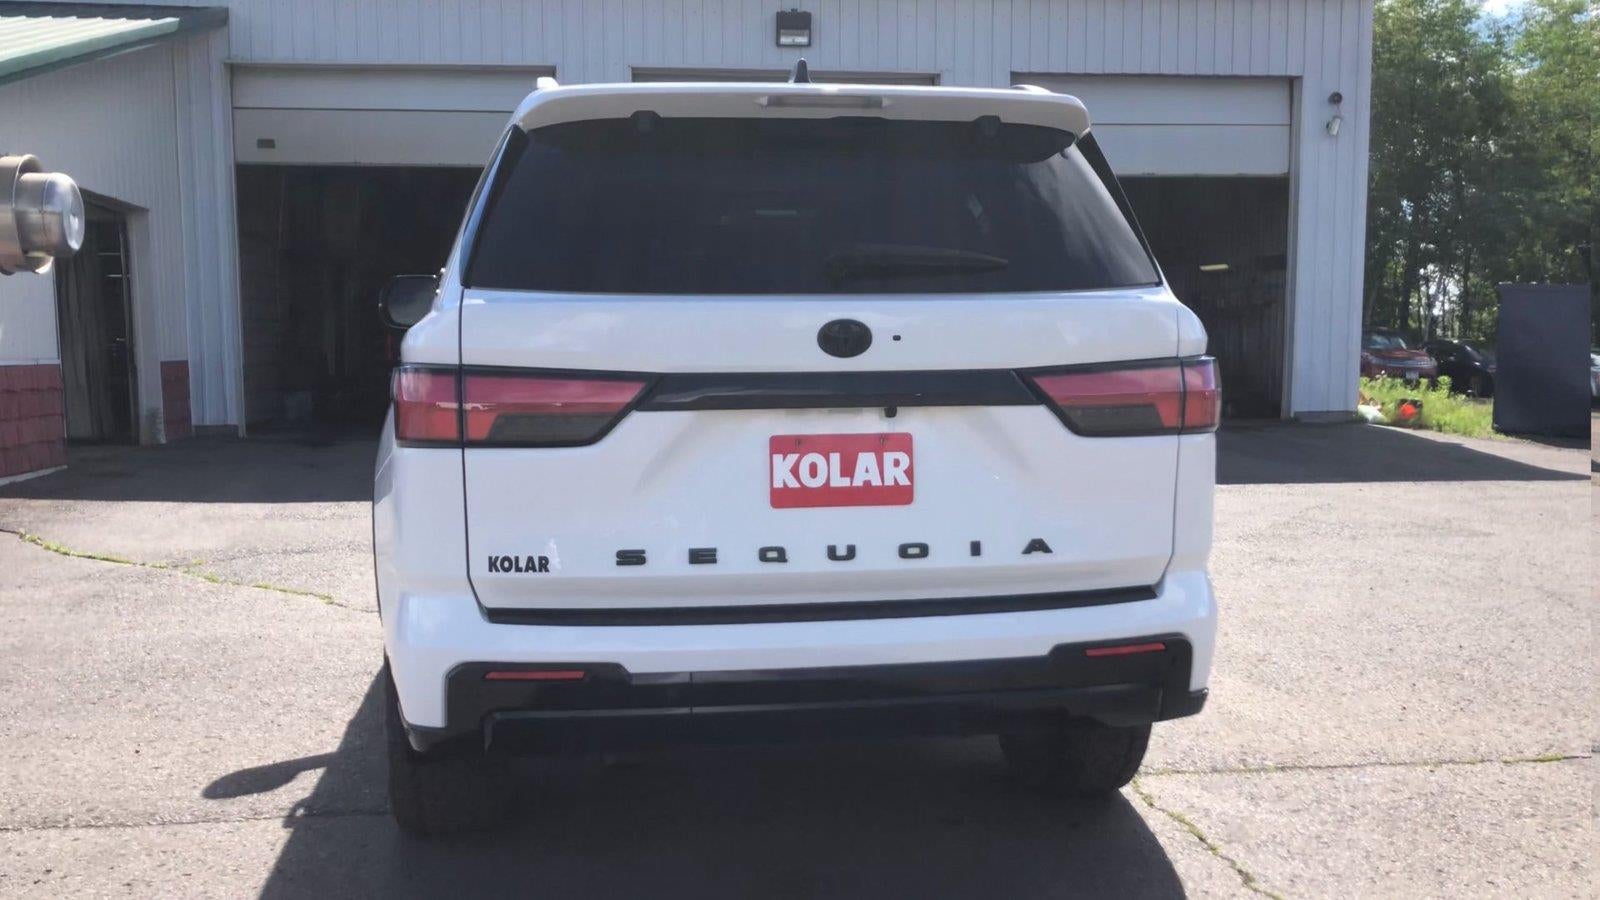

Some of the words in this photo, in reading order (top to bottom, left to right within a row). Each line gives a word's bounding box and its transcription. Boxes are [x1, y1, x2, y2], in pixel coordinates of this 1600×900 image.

[772, 451, 912, 488] KOLAR
[487, 555, 550, 573] KOLAR
[615, 538, 1054, 566] SEQUOIA
